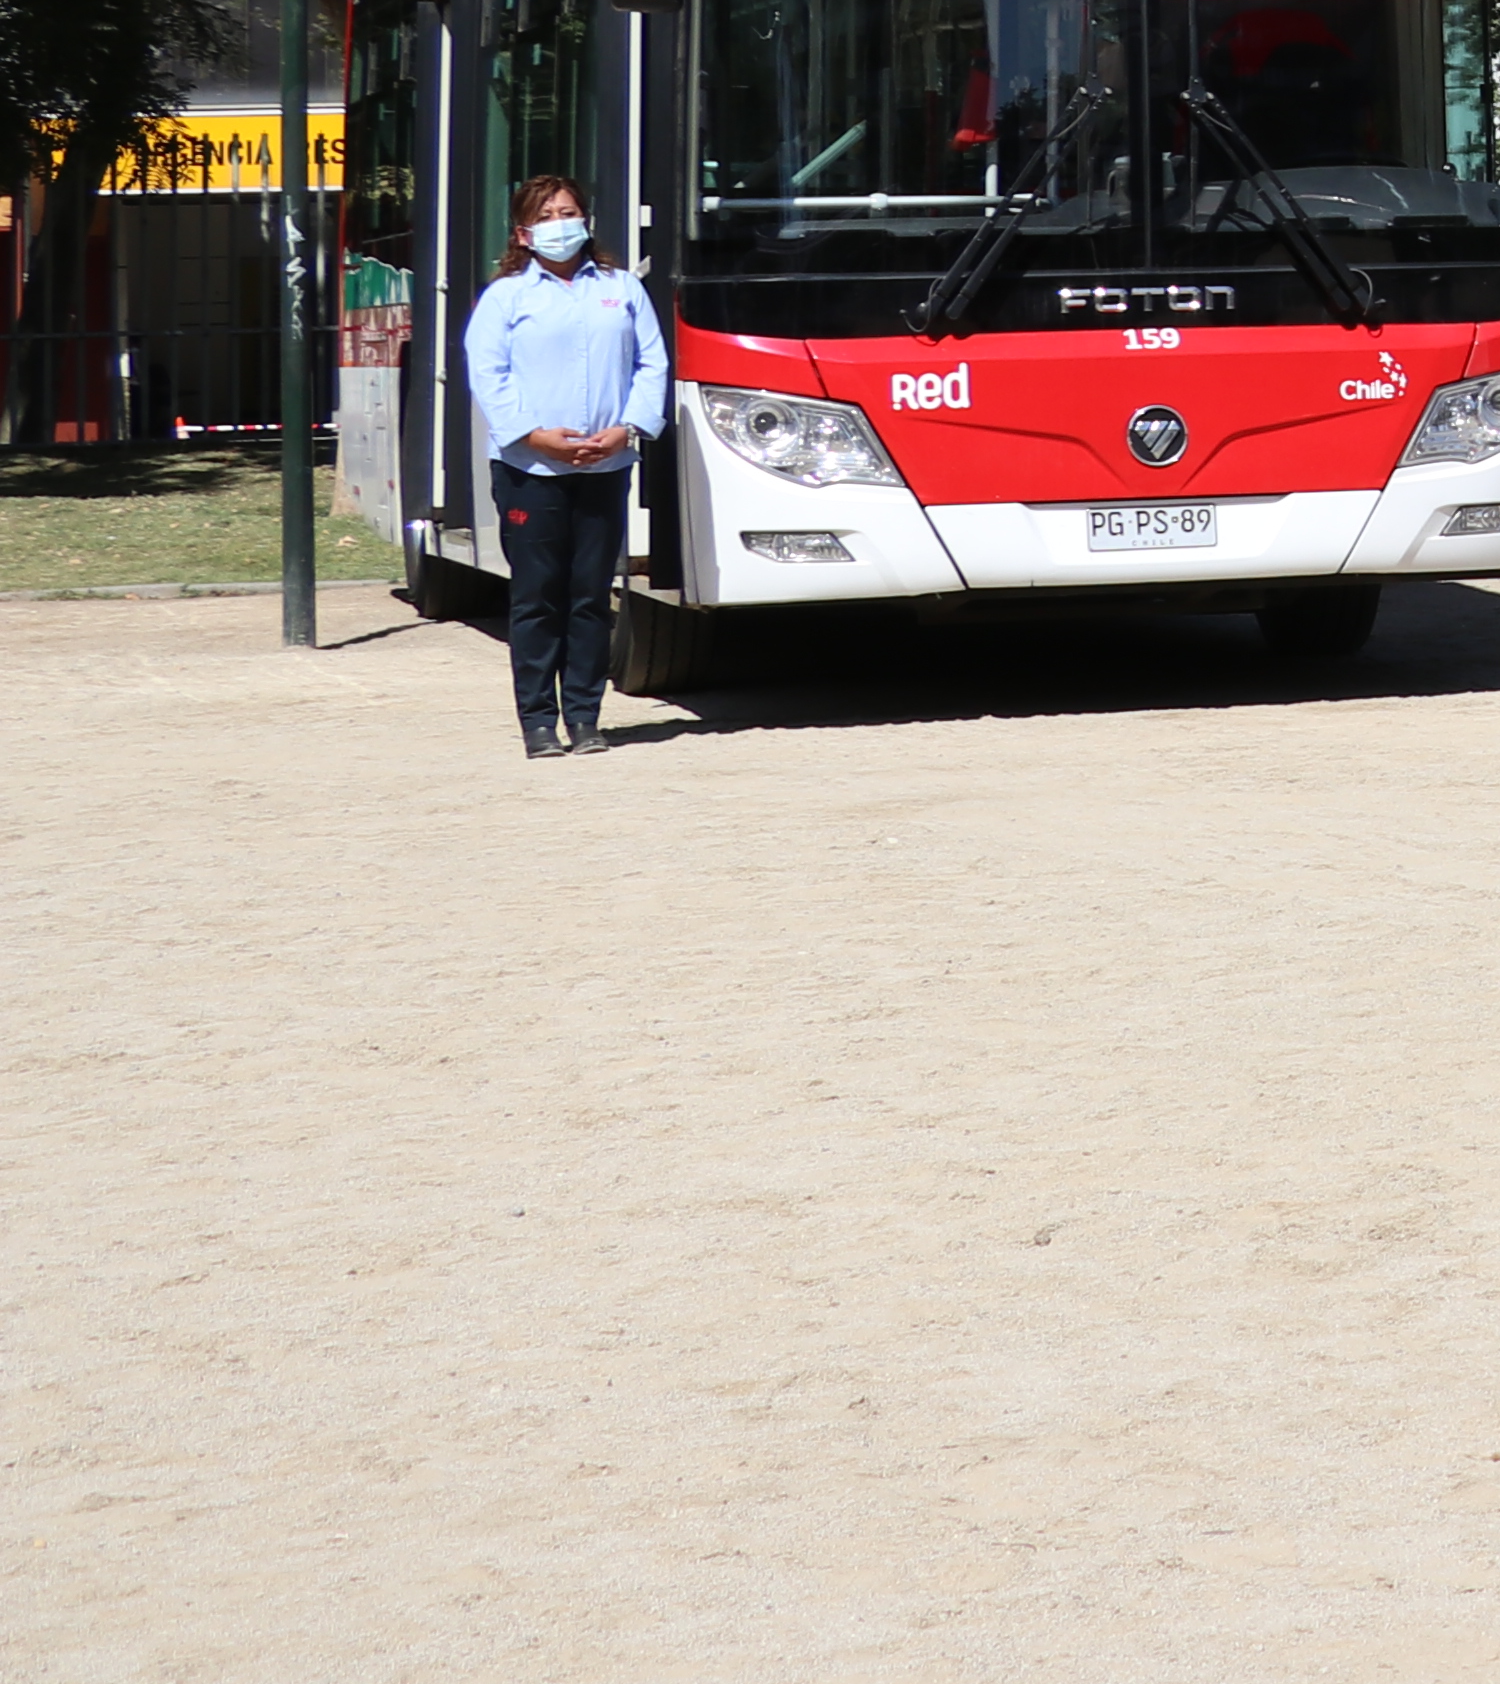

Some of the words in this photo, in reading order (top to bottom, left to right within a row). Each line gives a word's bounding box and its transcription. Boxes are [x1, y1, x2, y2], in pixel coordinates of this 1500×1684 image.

[1123, 328, 1180, 350] 159
[892, 363, 970, 410] Red
[1340, 380, 1395, 401] Chile
